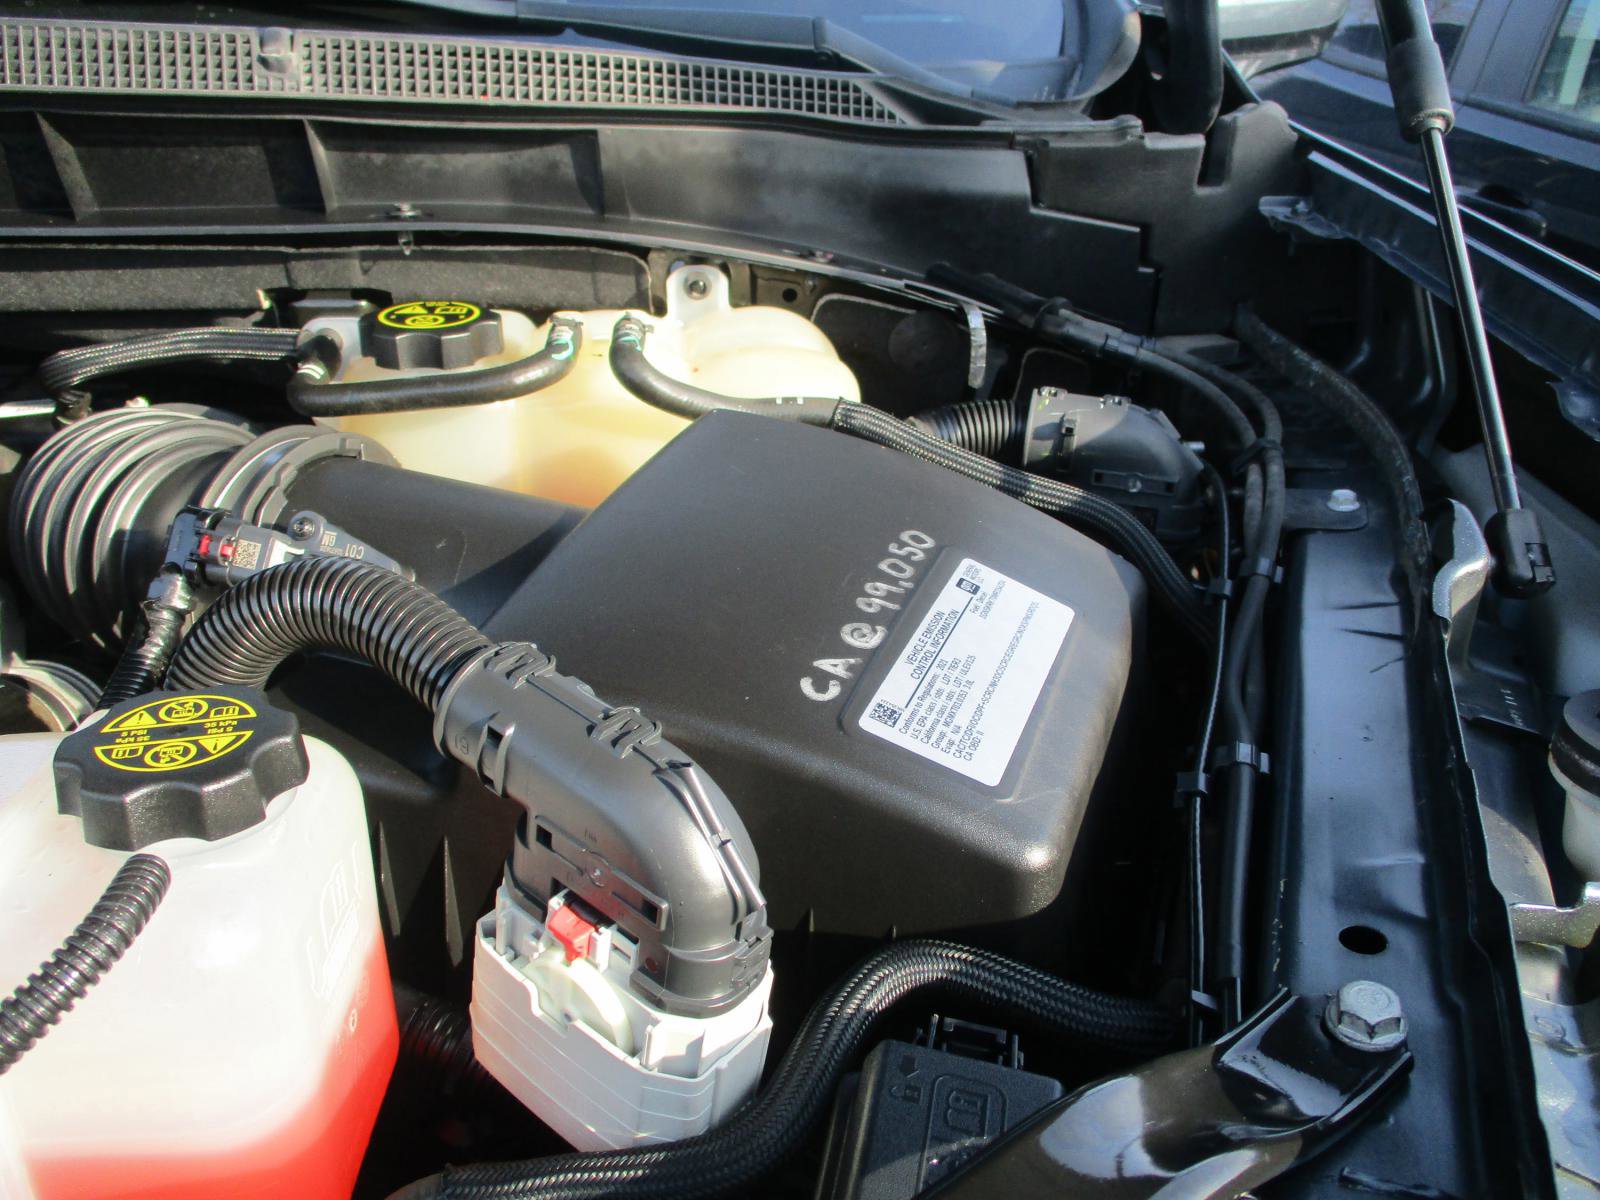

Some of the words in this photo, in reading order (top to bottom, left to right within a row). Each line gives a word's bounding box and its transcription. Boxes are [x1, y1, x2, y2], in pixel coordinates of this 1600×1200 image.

[800, 657, 863, 701] CA
[840, 622, 888, 650] @
[903, 637, 928, 666] VEHICLE
[920, 609, 946, 639] EMISSION
[909, 647, 936, 680] CONTROL
[928, 608, 960, 649] INFORMATION
[897, 706, 920, 735] Conforms
[913, 700, 924, 709] to
[915, 713, 929, 727] EPA
[922, 700, 937, 716] class
[940, 673, 953, 685] LDT
[919, 716, 941, 745] California
[933, 703, 948, 719] class
[951, 676, 964, 688] LDT
[962, 750, 974, 761] CA
